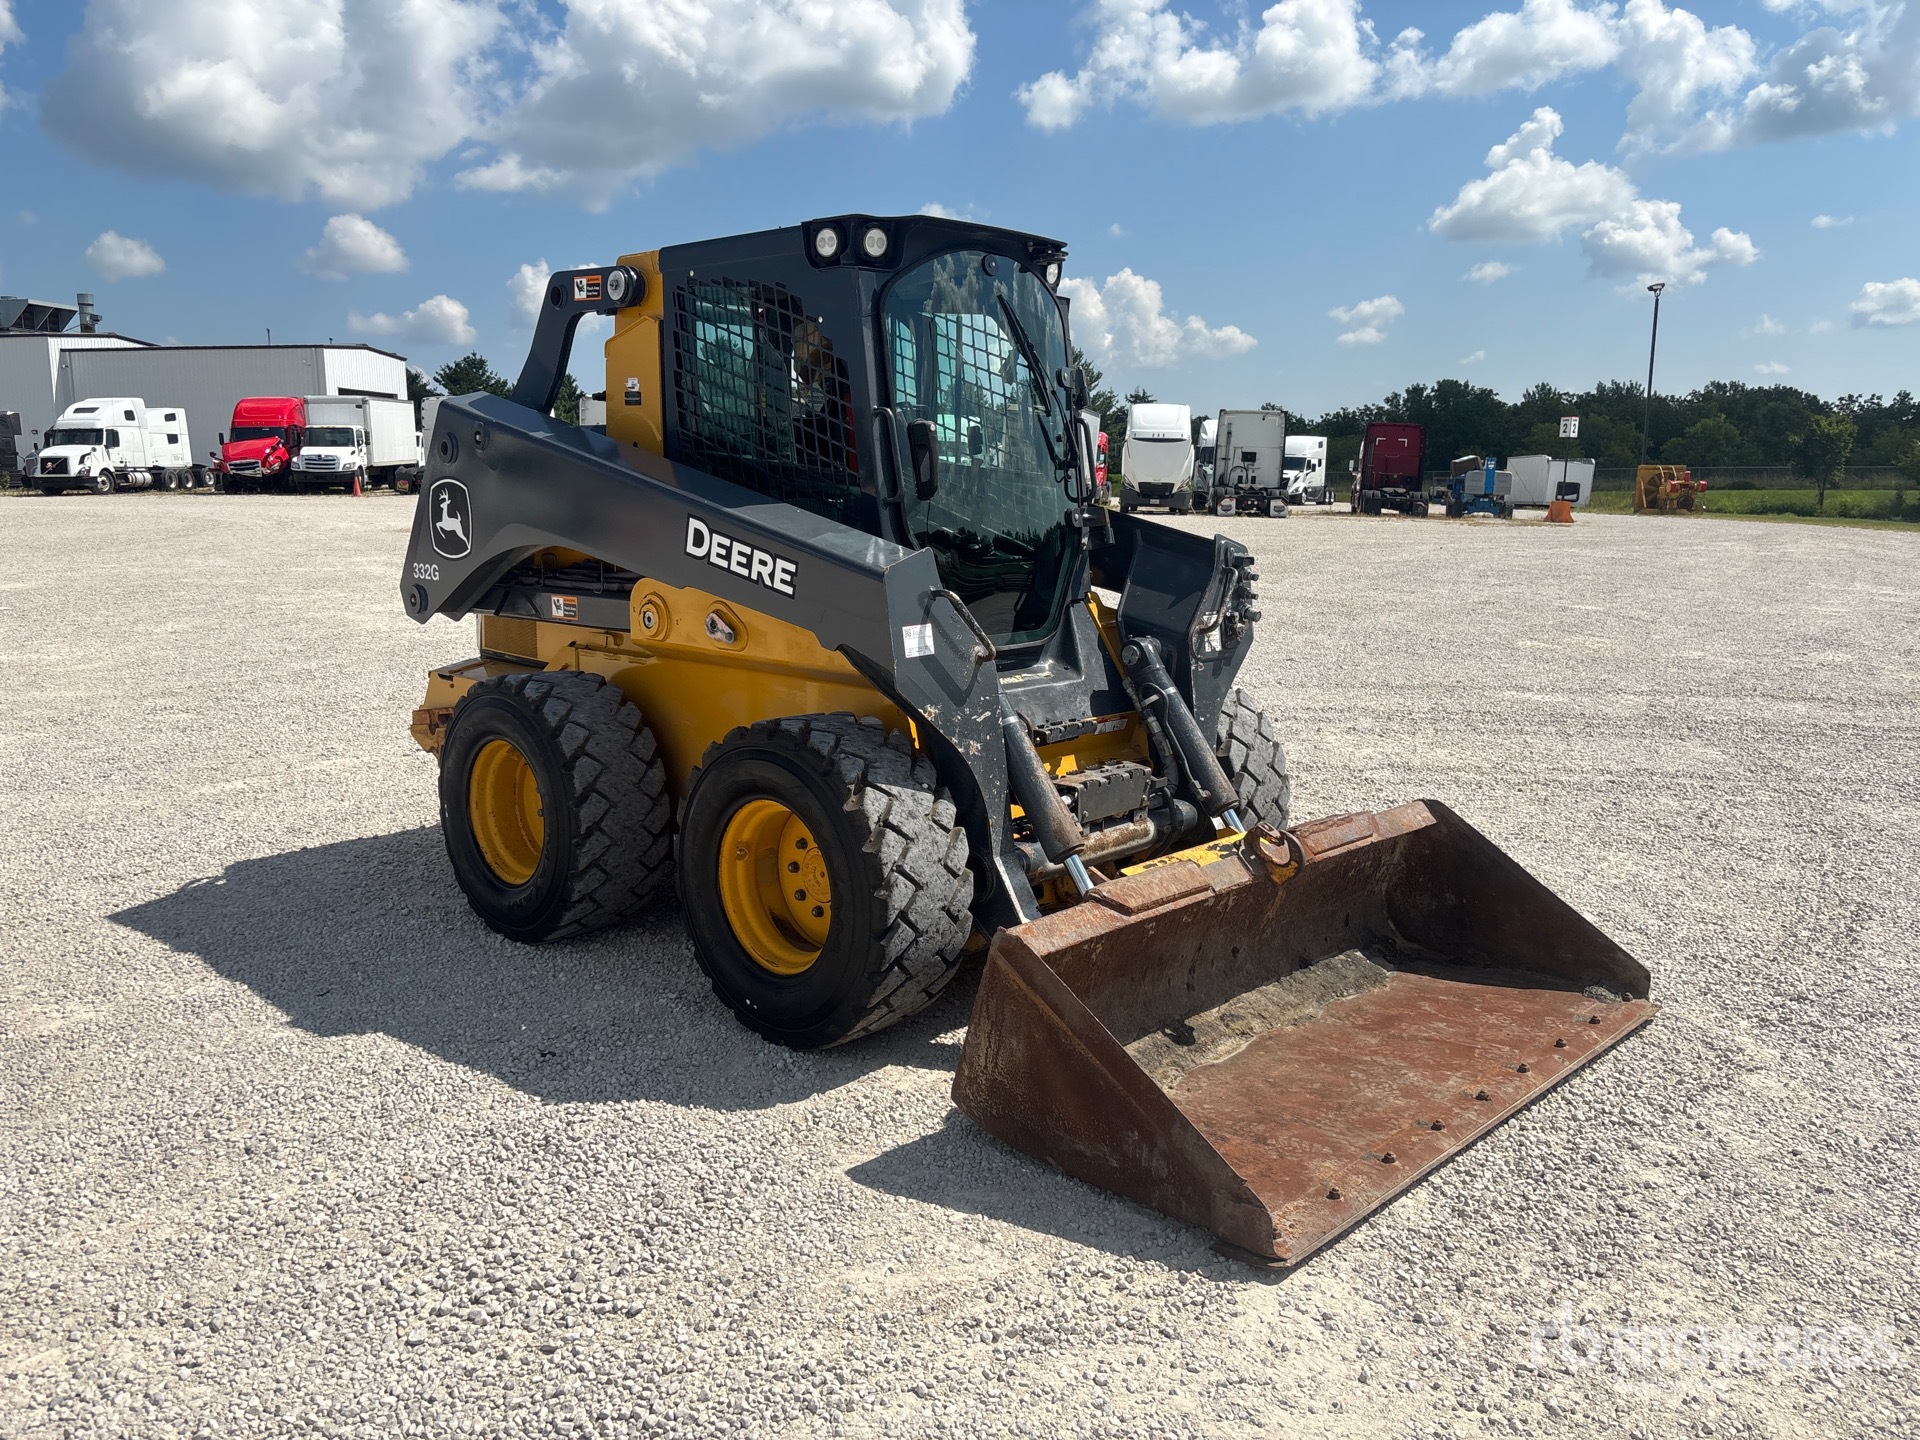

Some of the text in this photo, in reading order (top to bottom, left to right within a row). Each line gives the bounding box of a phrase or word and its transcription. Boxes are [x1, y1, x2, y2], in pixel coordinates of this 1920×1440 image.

[1562, 423, 1568, 434] 2
[686, 517, 797, 596] DEERE
[413, 562, 440, 581] 332G
